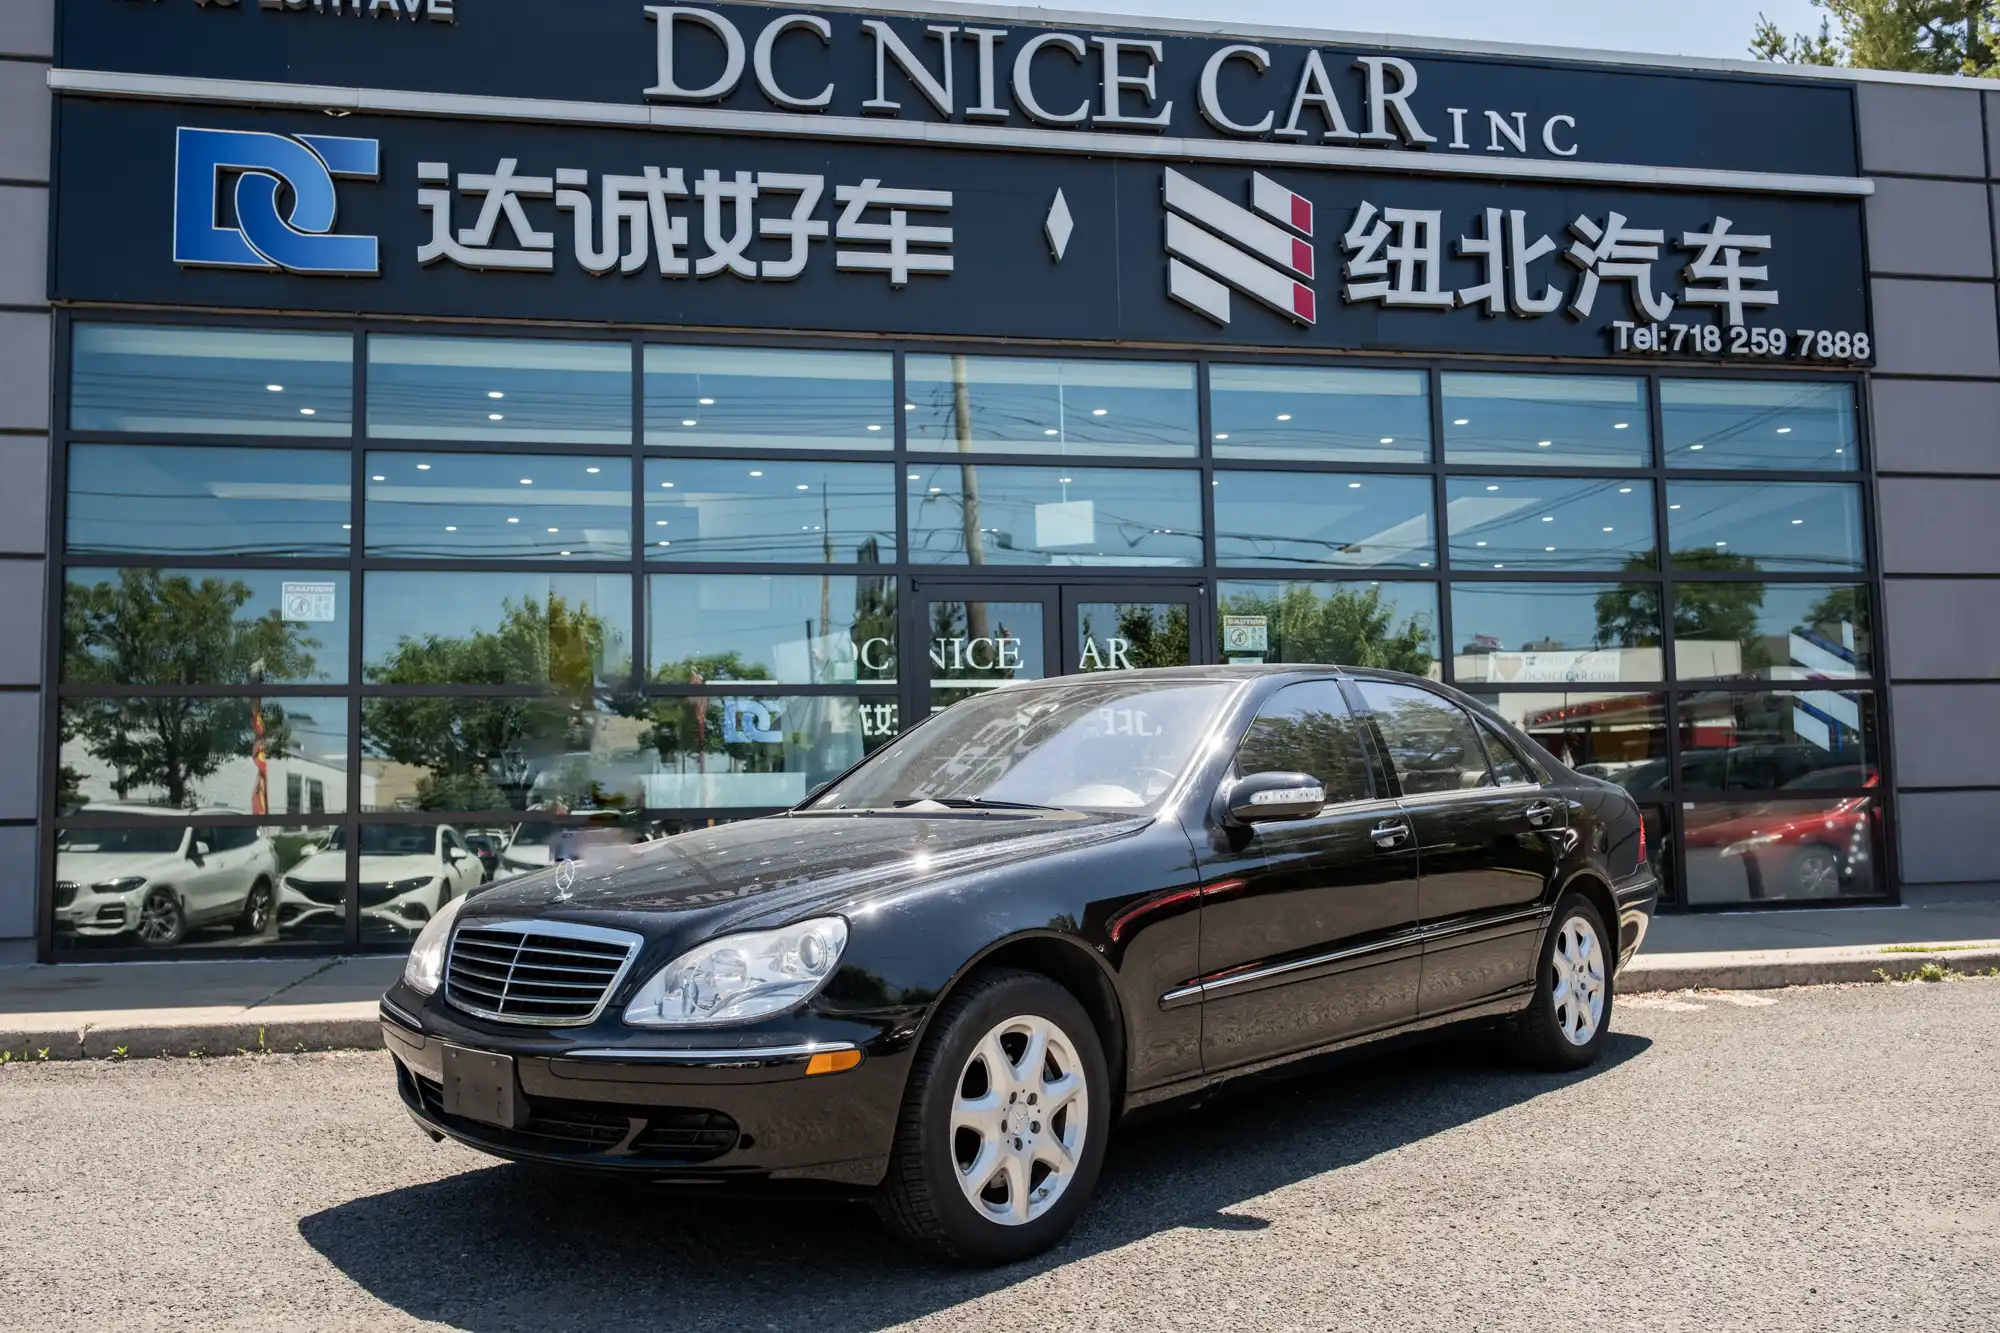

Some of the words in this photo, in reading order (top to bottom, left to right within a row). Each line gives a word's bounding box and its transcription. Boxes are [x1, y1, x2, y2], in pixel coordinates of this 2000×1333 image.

[643, 5, 835, 109] DC
[861, 19, 1173, 130] NICE
[1200, 45, 1437, 143] CAR
[1446, 107, 1578, 156] INC
[173, 126, 379, 276] DC
[417, 158, 954, 287] 达诚好车
[1343, 200, 1780, 326] 纽北汽车
[1730, 326, 1788, 355] 259
[1797, 329, 1871, 359] 7888
[287, 585, 334, 593] CAUTION
[851, 636, 890, 670] C
[929, 637, 1024, 670] NICE
